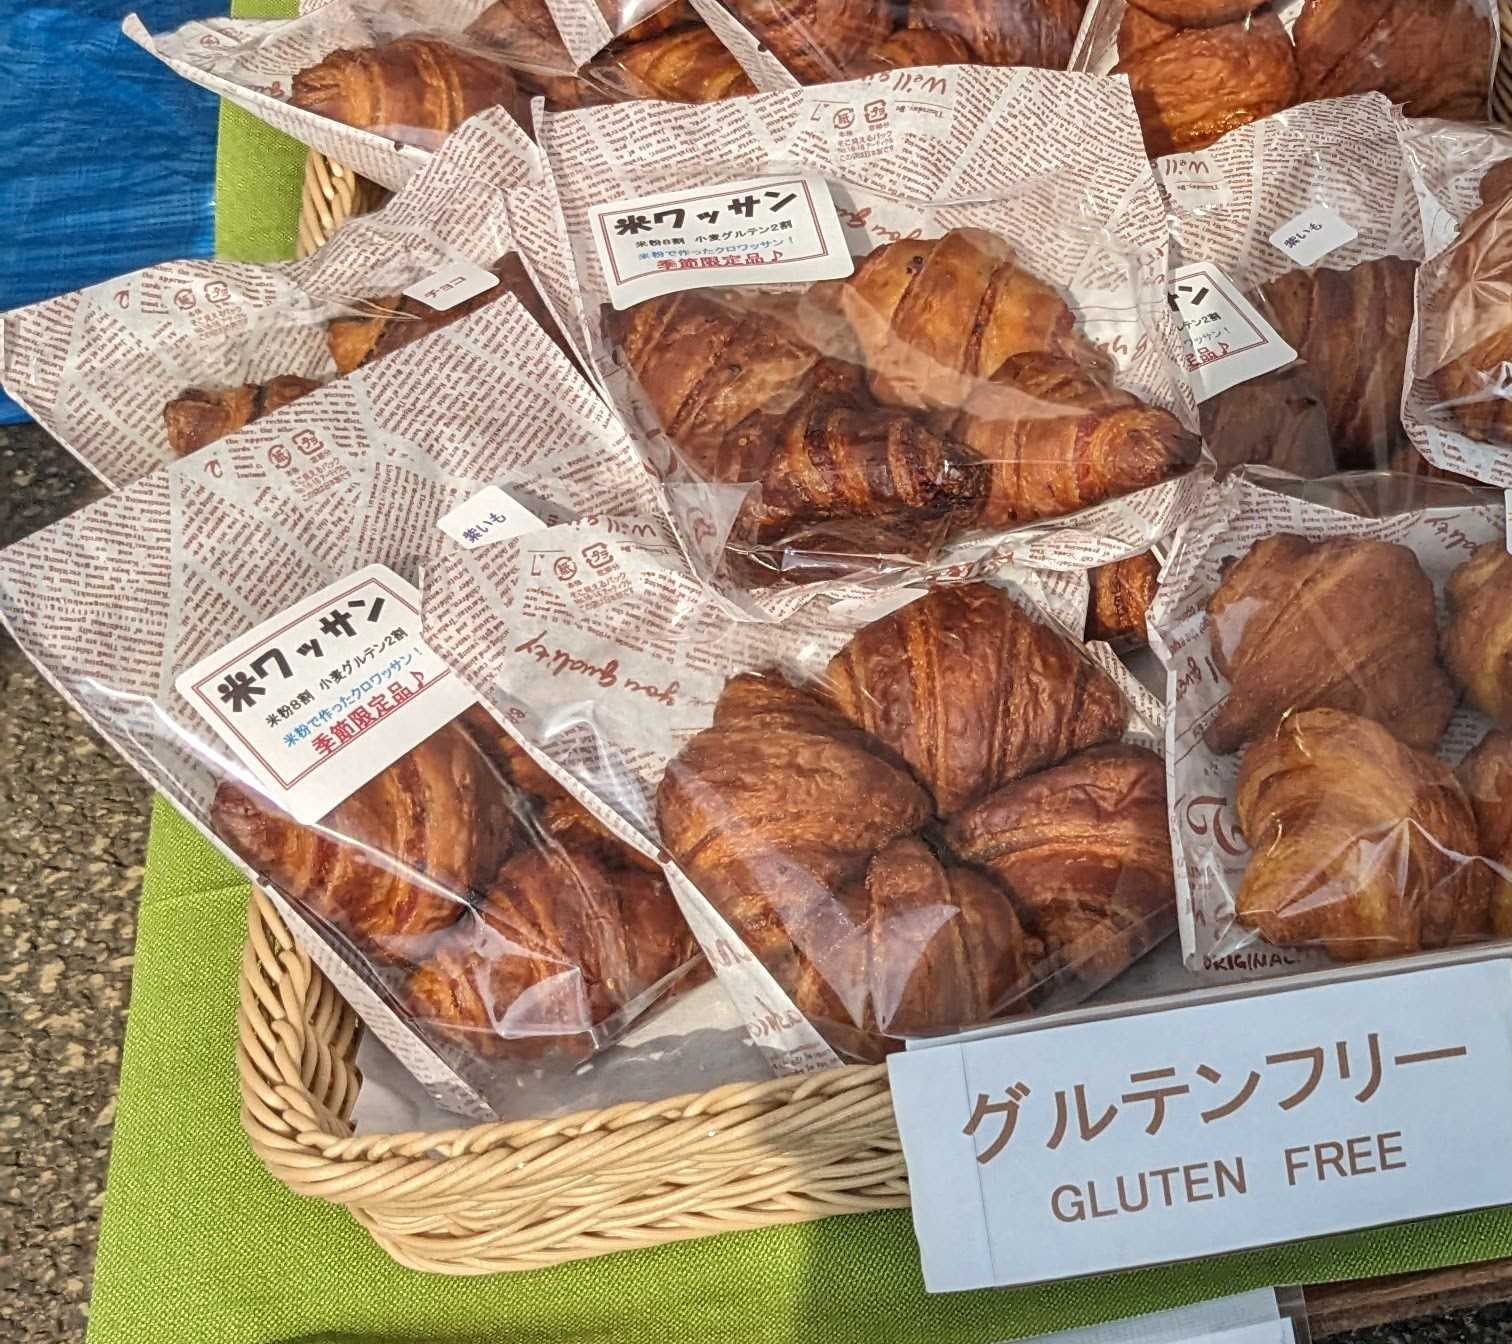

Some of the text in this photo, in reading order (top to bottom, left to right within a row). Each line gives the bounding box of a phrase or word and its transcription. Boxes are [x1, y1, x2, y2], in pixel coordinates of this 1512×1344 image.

[614, 191, 798, 236] 米ワッサン
[424, 277, 466, 298] チョコ
[463, 512, 506, 544] 紫いも
[217, 597, 386, 713] 米ワッサン
[961, 1033, 1468, 1164] グルテンフリー
[1051, 1131, 1407, 1224] GLUTEN FREE
